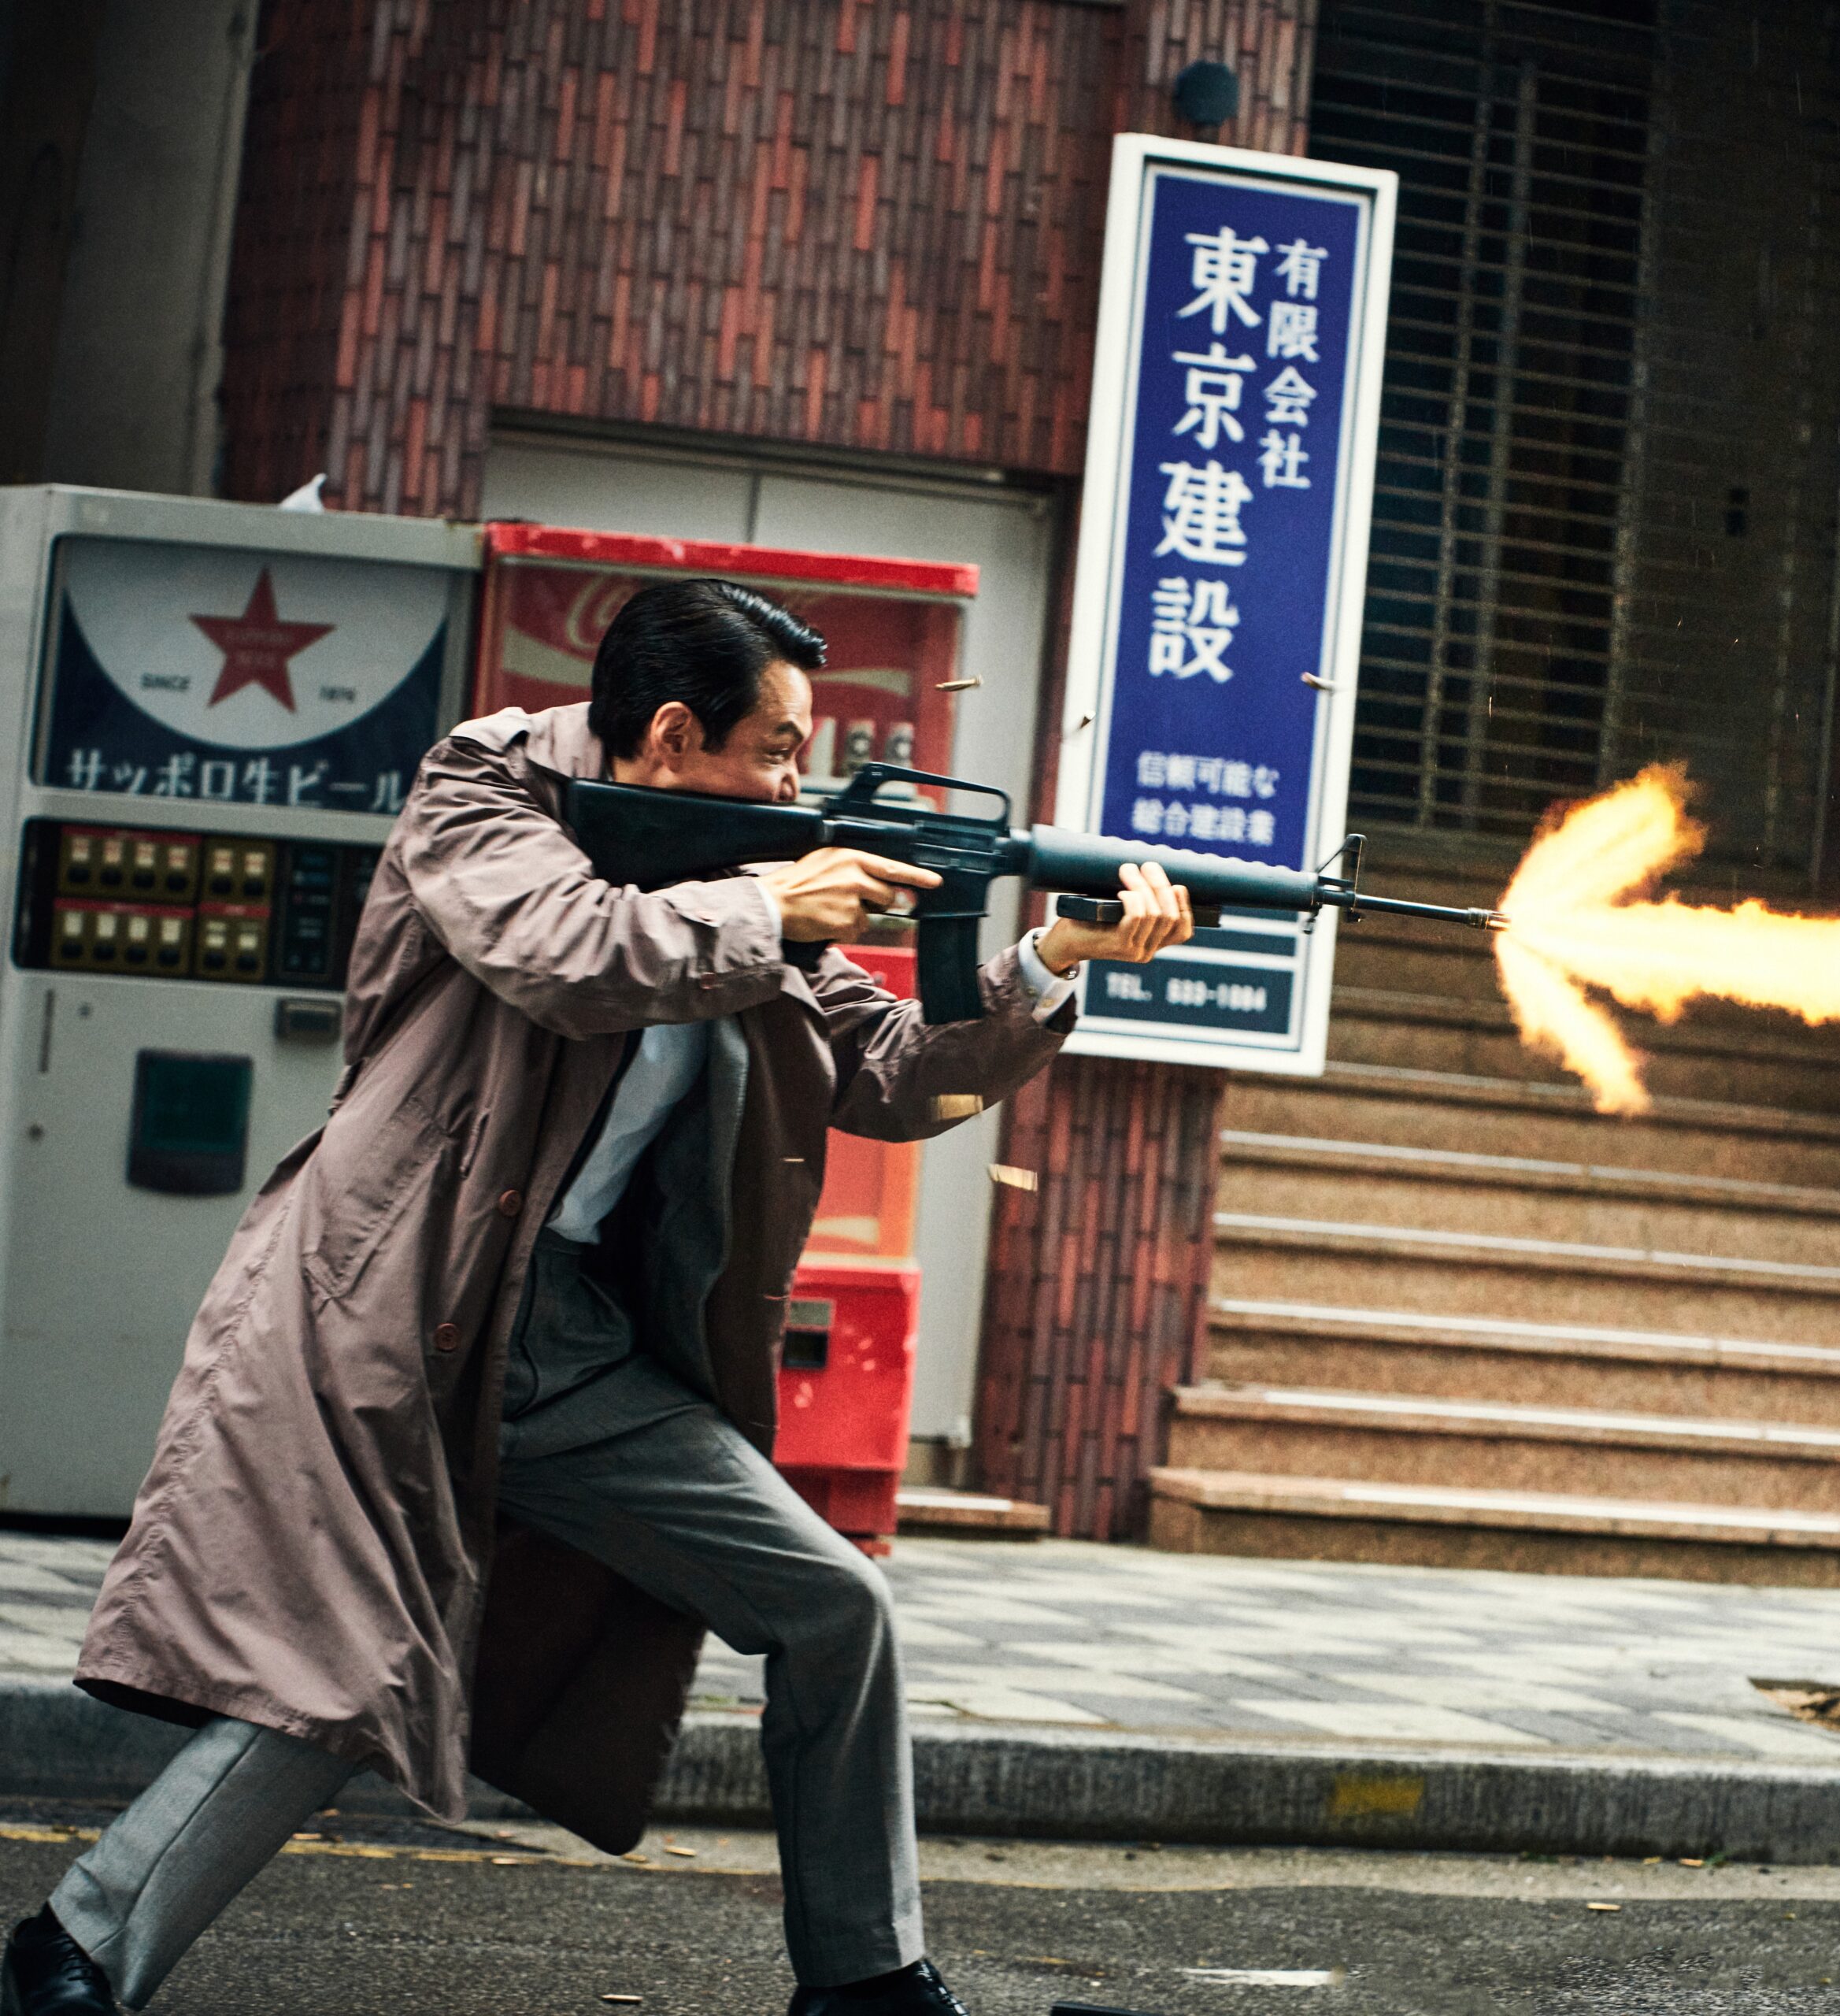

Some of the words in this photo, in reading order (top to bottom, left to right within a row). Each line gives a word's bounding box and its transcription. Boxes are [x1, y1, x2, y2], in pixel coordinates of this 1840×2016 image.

[1257, 238, 1329, 490] 有限会社
[1150, 226, 1270, 684] 東京建設
[66, 748, 406, 814] サッポロ生ビール
[1106, 972, 1153, 1002] TEL.
